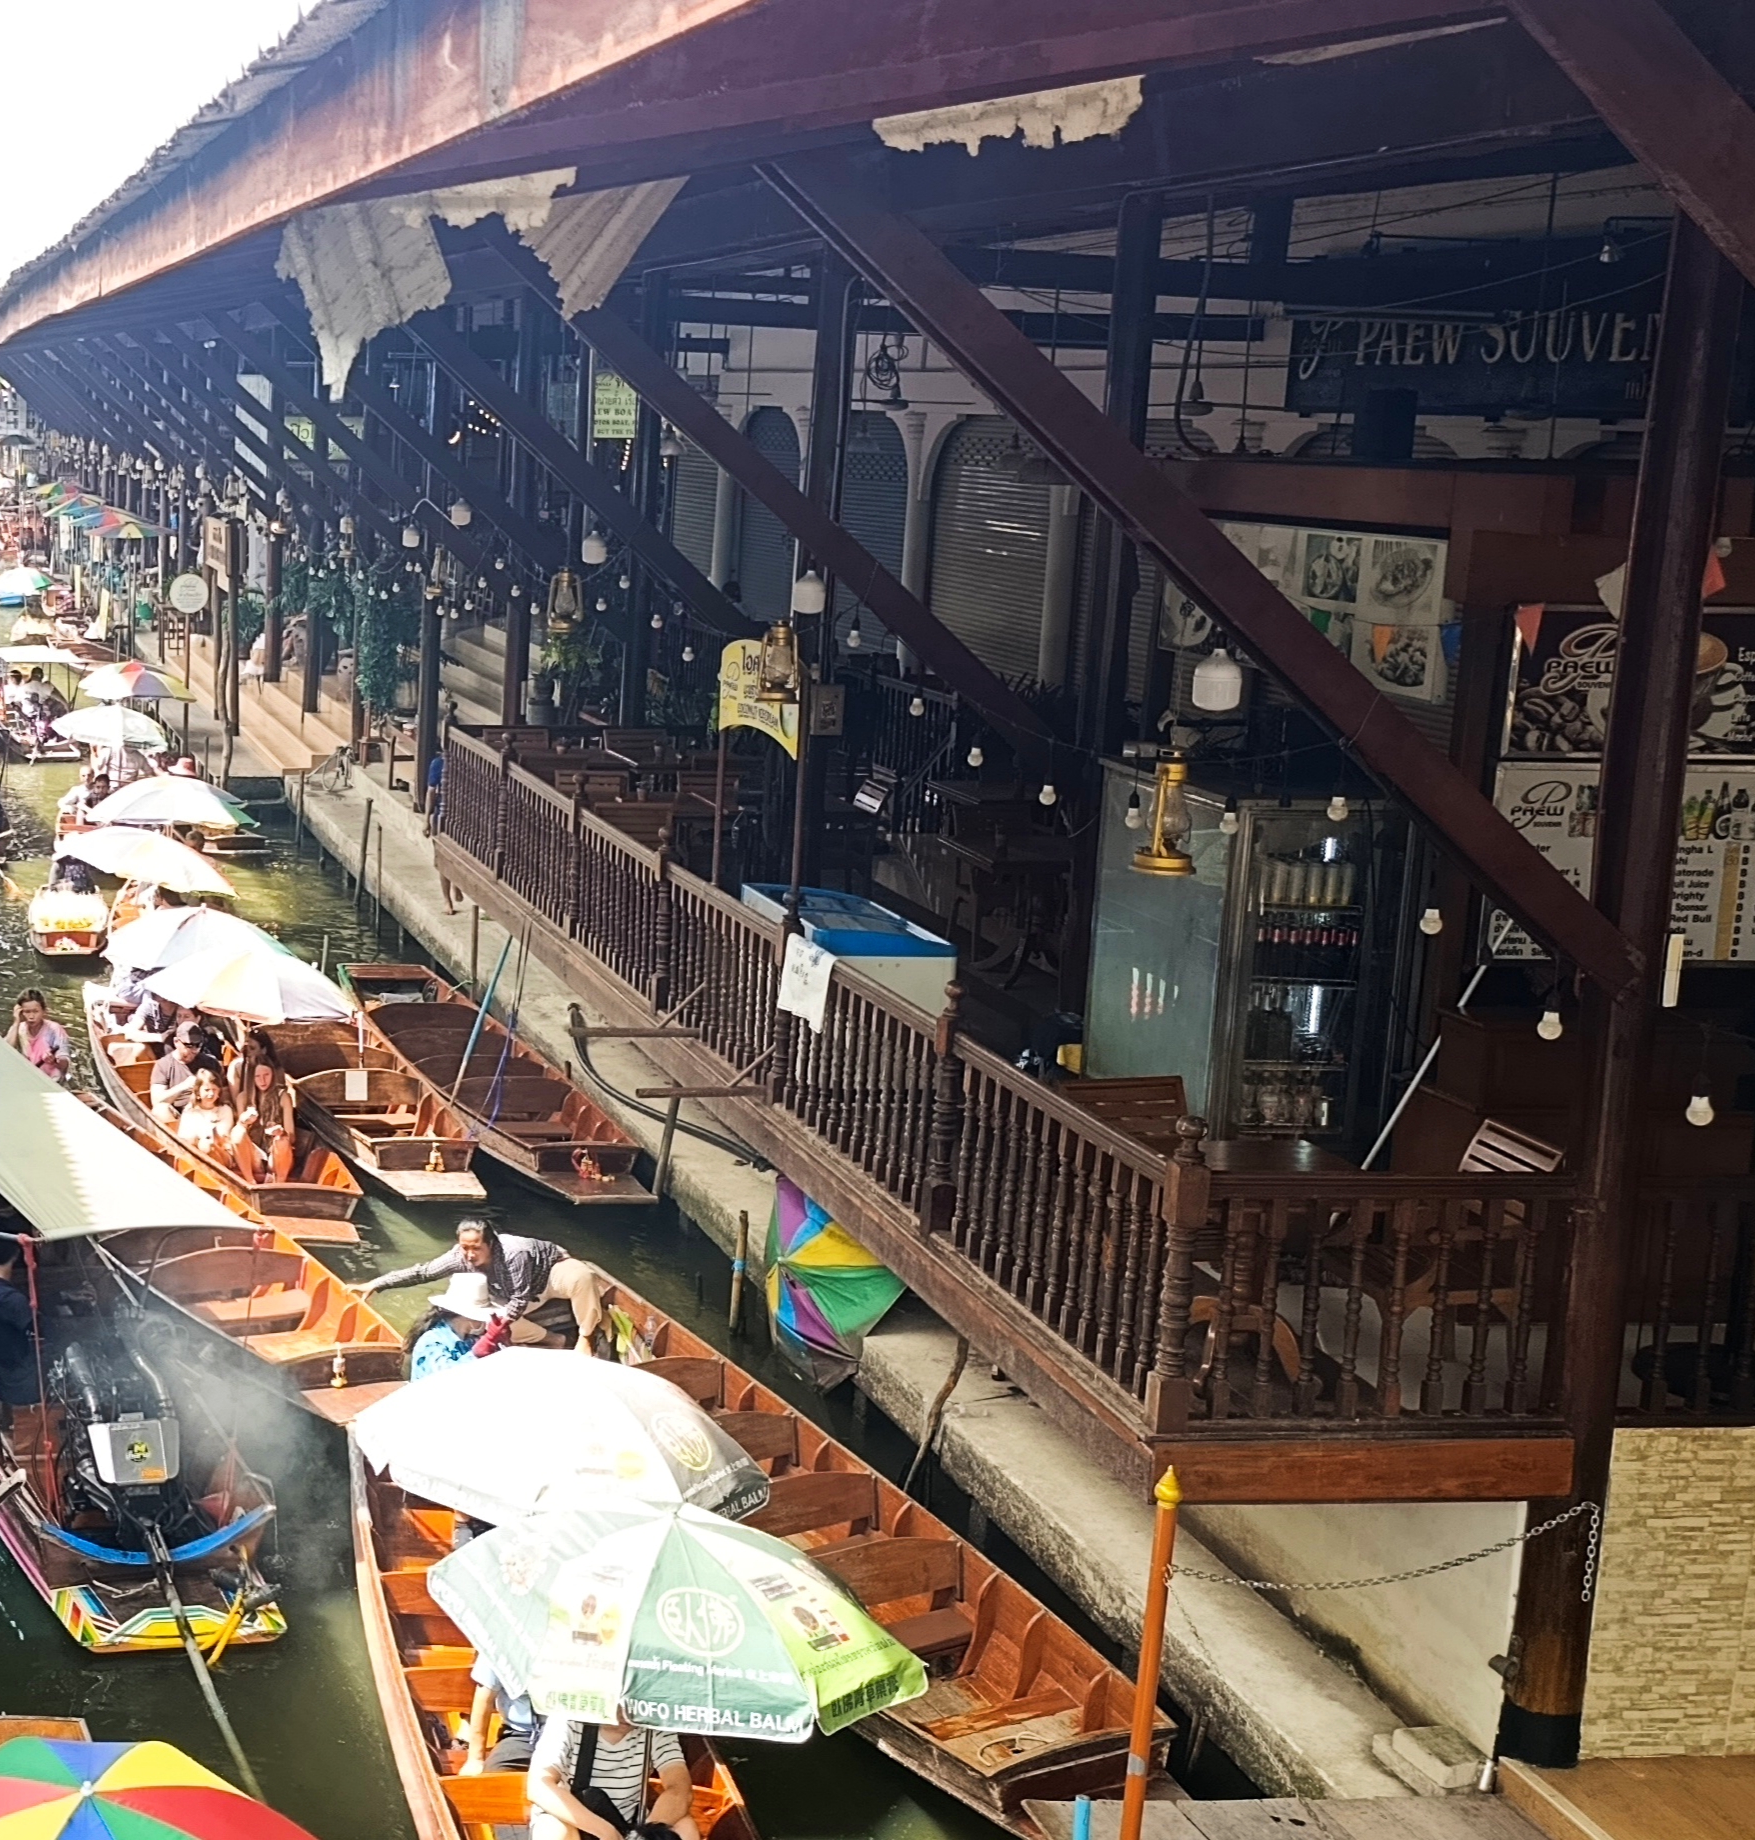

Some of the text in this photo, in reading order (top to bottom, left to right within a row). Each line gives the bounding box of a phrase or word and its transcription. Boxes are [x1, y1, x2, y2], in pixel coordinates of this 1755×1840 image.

[1355, 318, 1464, 364] PAEW
[1510, 806, 1565, 817] PAEW
[1675, 869, 1714, 877] atorade
[662, 1659, 705, 1677] Floating
[674, 1704, 745, 1727] HERBAL
